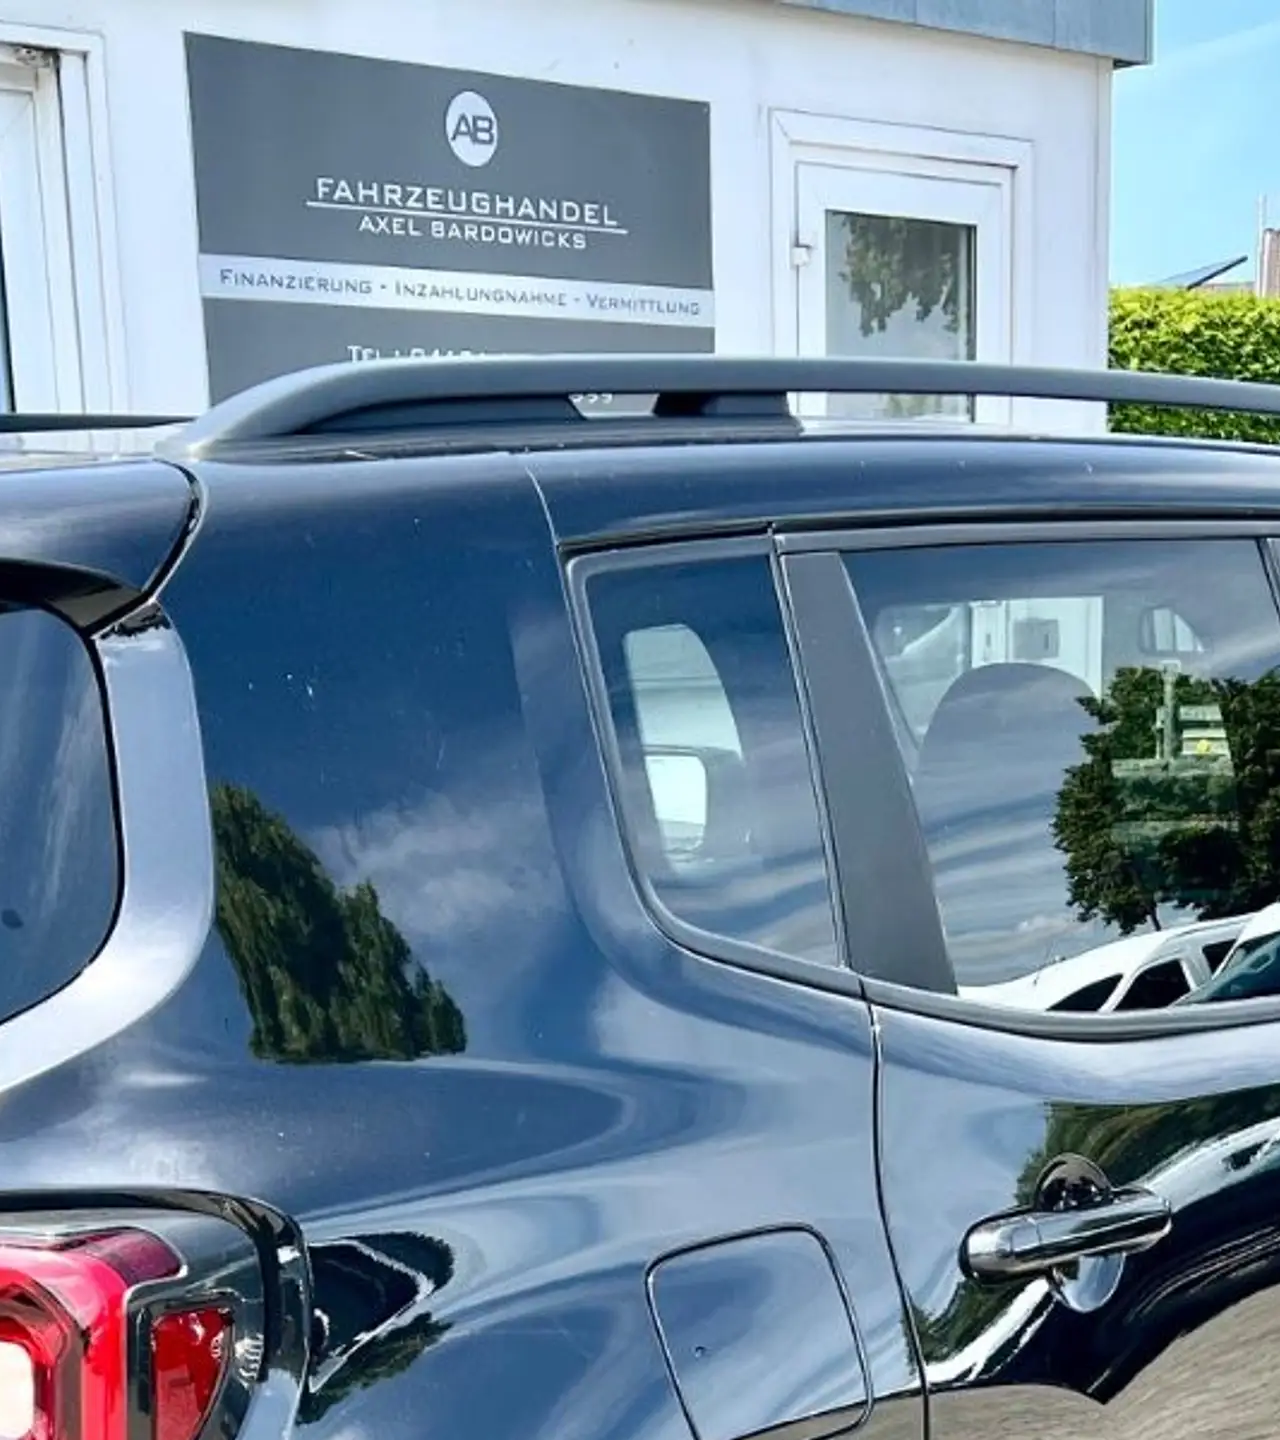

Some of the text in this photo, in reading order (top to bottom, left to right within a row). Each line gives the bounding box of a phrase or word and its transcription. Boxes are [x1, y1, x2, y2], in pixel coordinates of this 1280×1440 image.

[451, 112, 495, 146] AB
[316, 176, 619, 227] FAHRZEUGHANDEL
[358, 214, 587, 250] AXEL BARDOWICKS
[219, 268, 701, 317] FINANZIERUNG INZAHLUNGNAHME VERMITTLUNG
